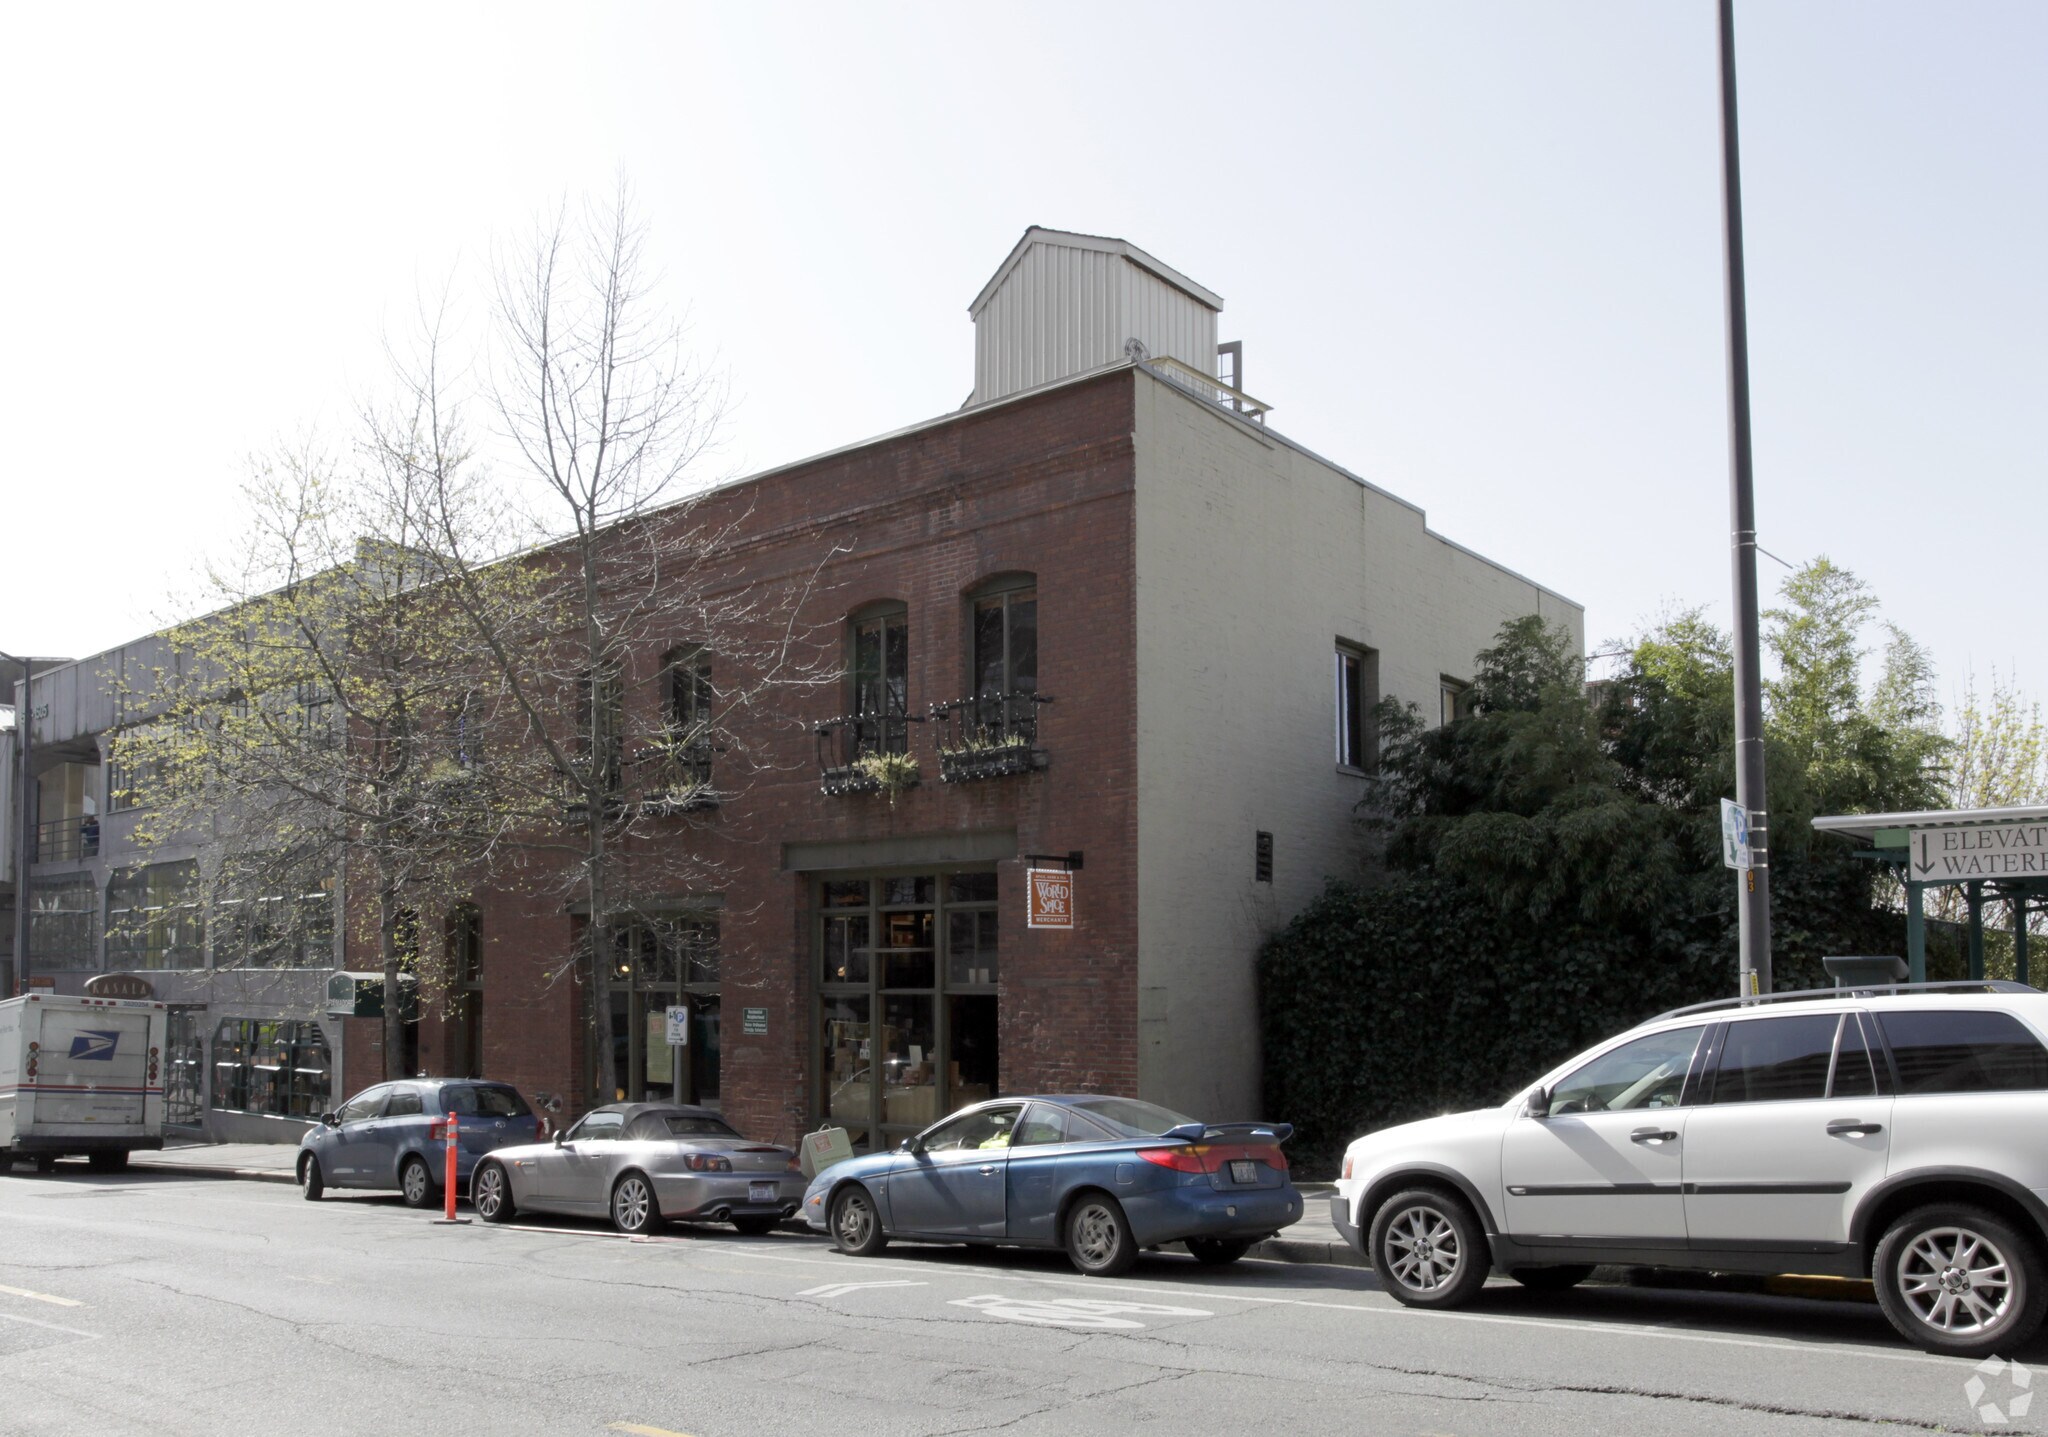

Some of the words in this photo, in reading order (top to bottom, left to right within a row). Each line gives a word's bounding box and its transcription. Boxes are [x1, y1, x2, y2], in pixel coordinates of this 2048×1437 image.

[1942, 826, 2048, 851] ELEVAT
[1035, 882, 1069, 899] WORLD
[1040, 897, 1065, 913] SPICE
[92, 982, 147, 995] KASALA
